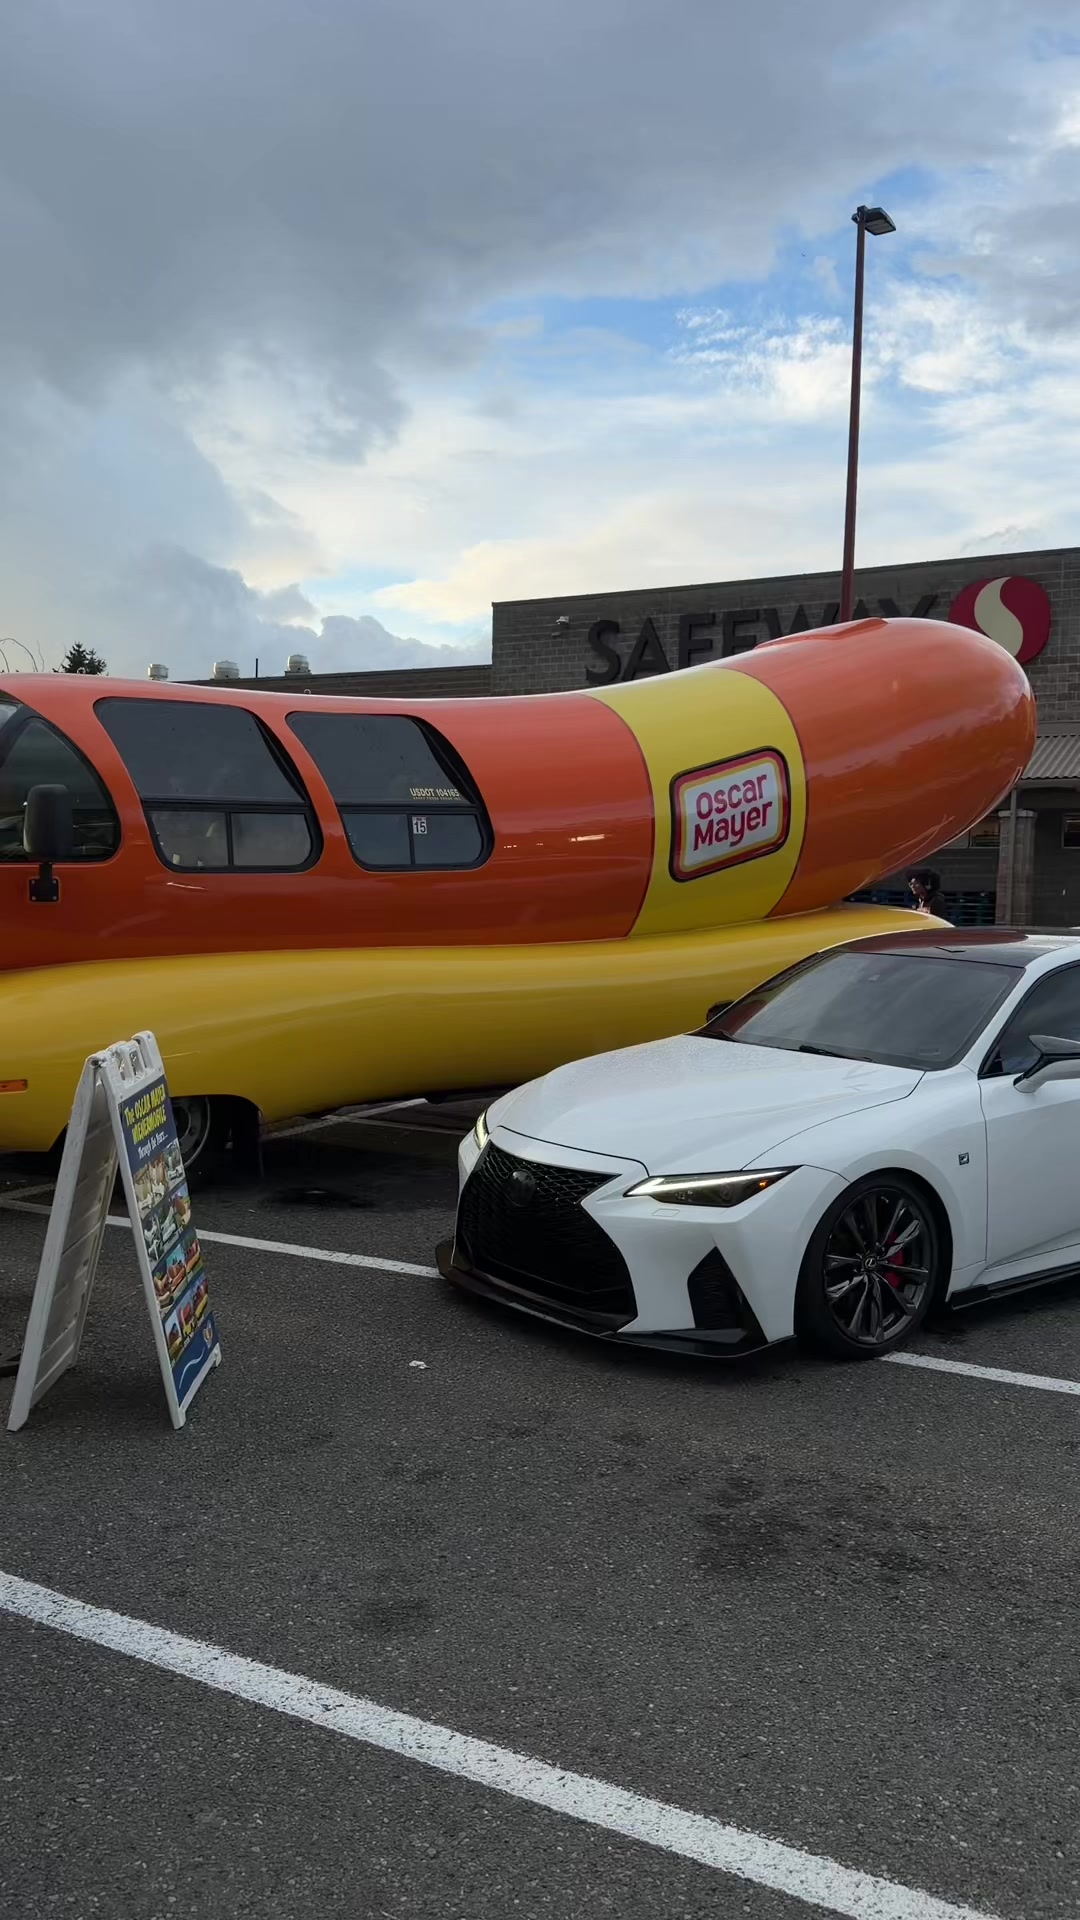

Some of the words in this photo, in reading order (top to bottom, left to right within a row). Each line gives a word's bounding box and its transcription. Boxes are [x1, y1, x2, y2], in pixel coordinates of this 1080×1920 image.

[410, 788, 434, 797] USDOT
[696, 774, 767, 819] Oscar
[414, 821, 426, 833] 15
[693, 801, 773, 851] Mayer
[124, 1106, 135, 1126] The
[134, 1093, 151, 1119] OSCAR
